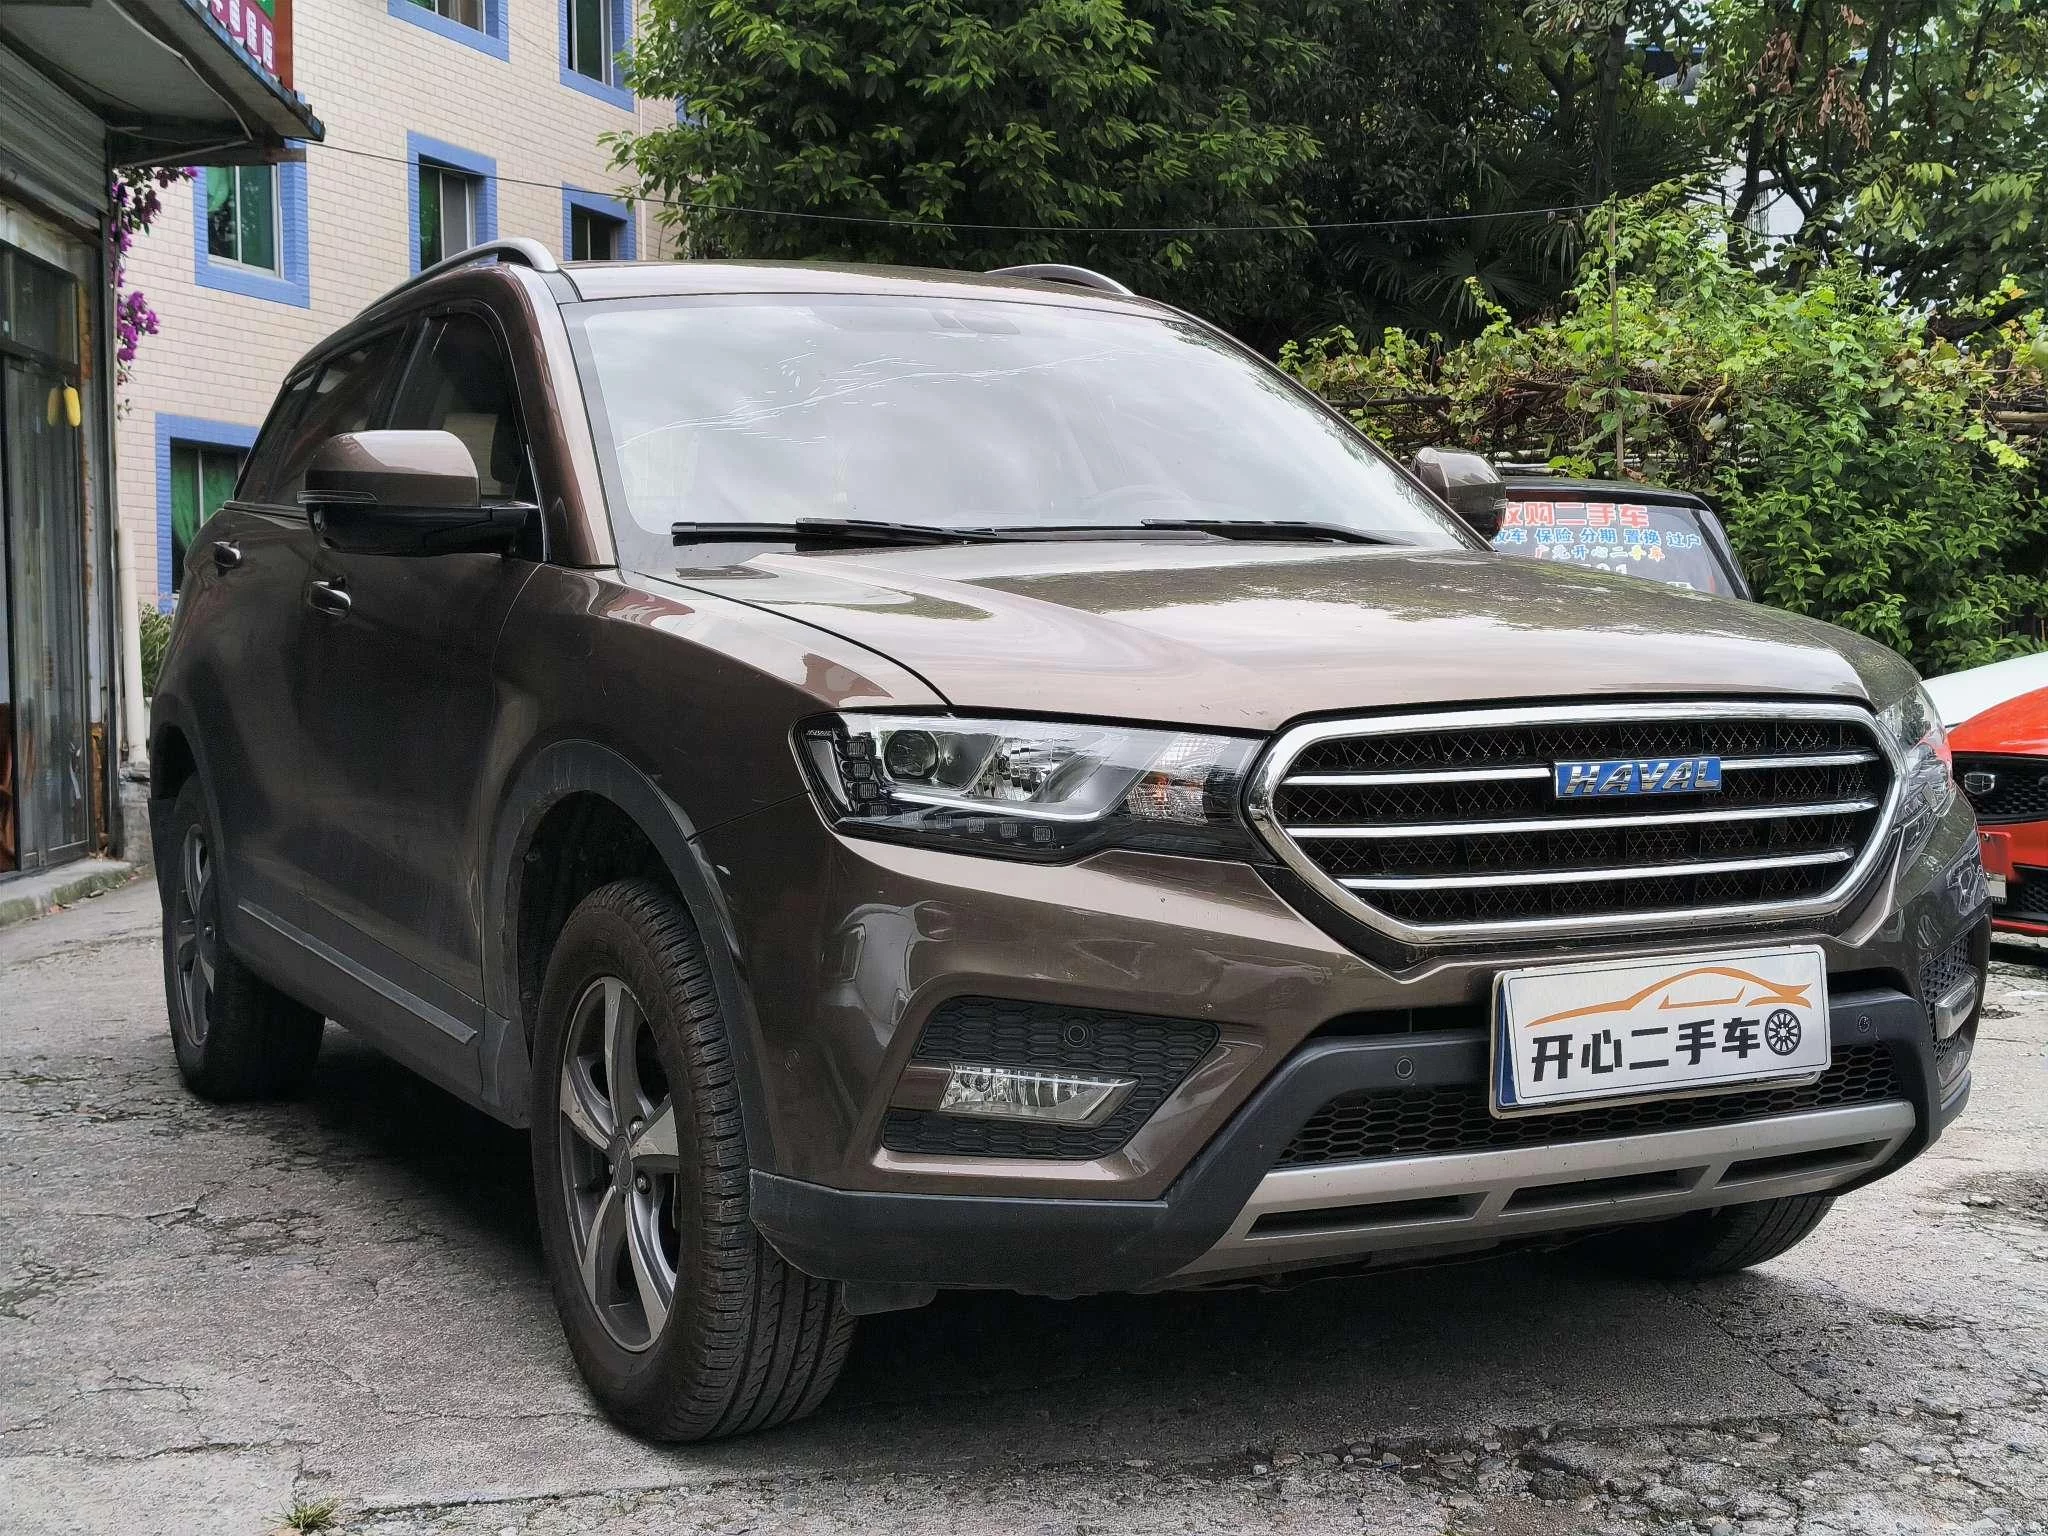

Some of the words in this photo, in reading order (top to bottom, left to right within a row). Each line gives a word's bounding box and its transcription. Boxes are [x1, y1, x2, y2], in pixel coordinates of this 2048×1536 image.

[1535, 528, 1574, 544] 保险
[1580, 528, 1617, 544] 分期
[1624, 529, 1661, 545] 置换
[1666, 531, 1701, 548] 过户
[1565, 761, 1719, 794] HAVAL
[1532, 1017, 1761, 1082] 开心二手车
